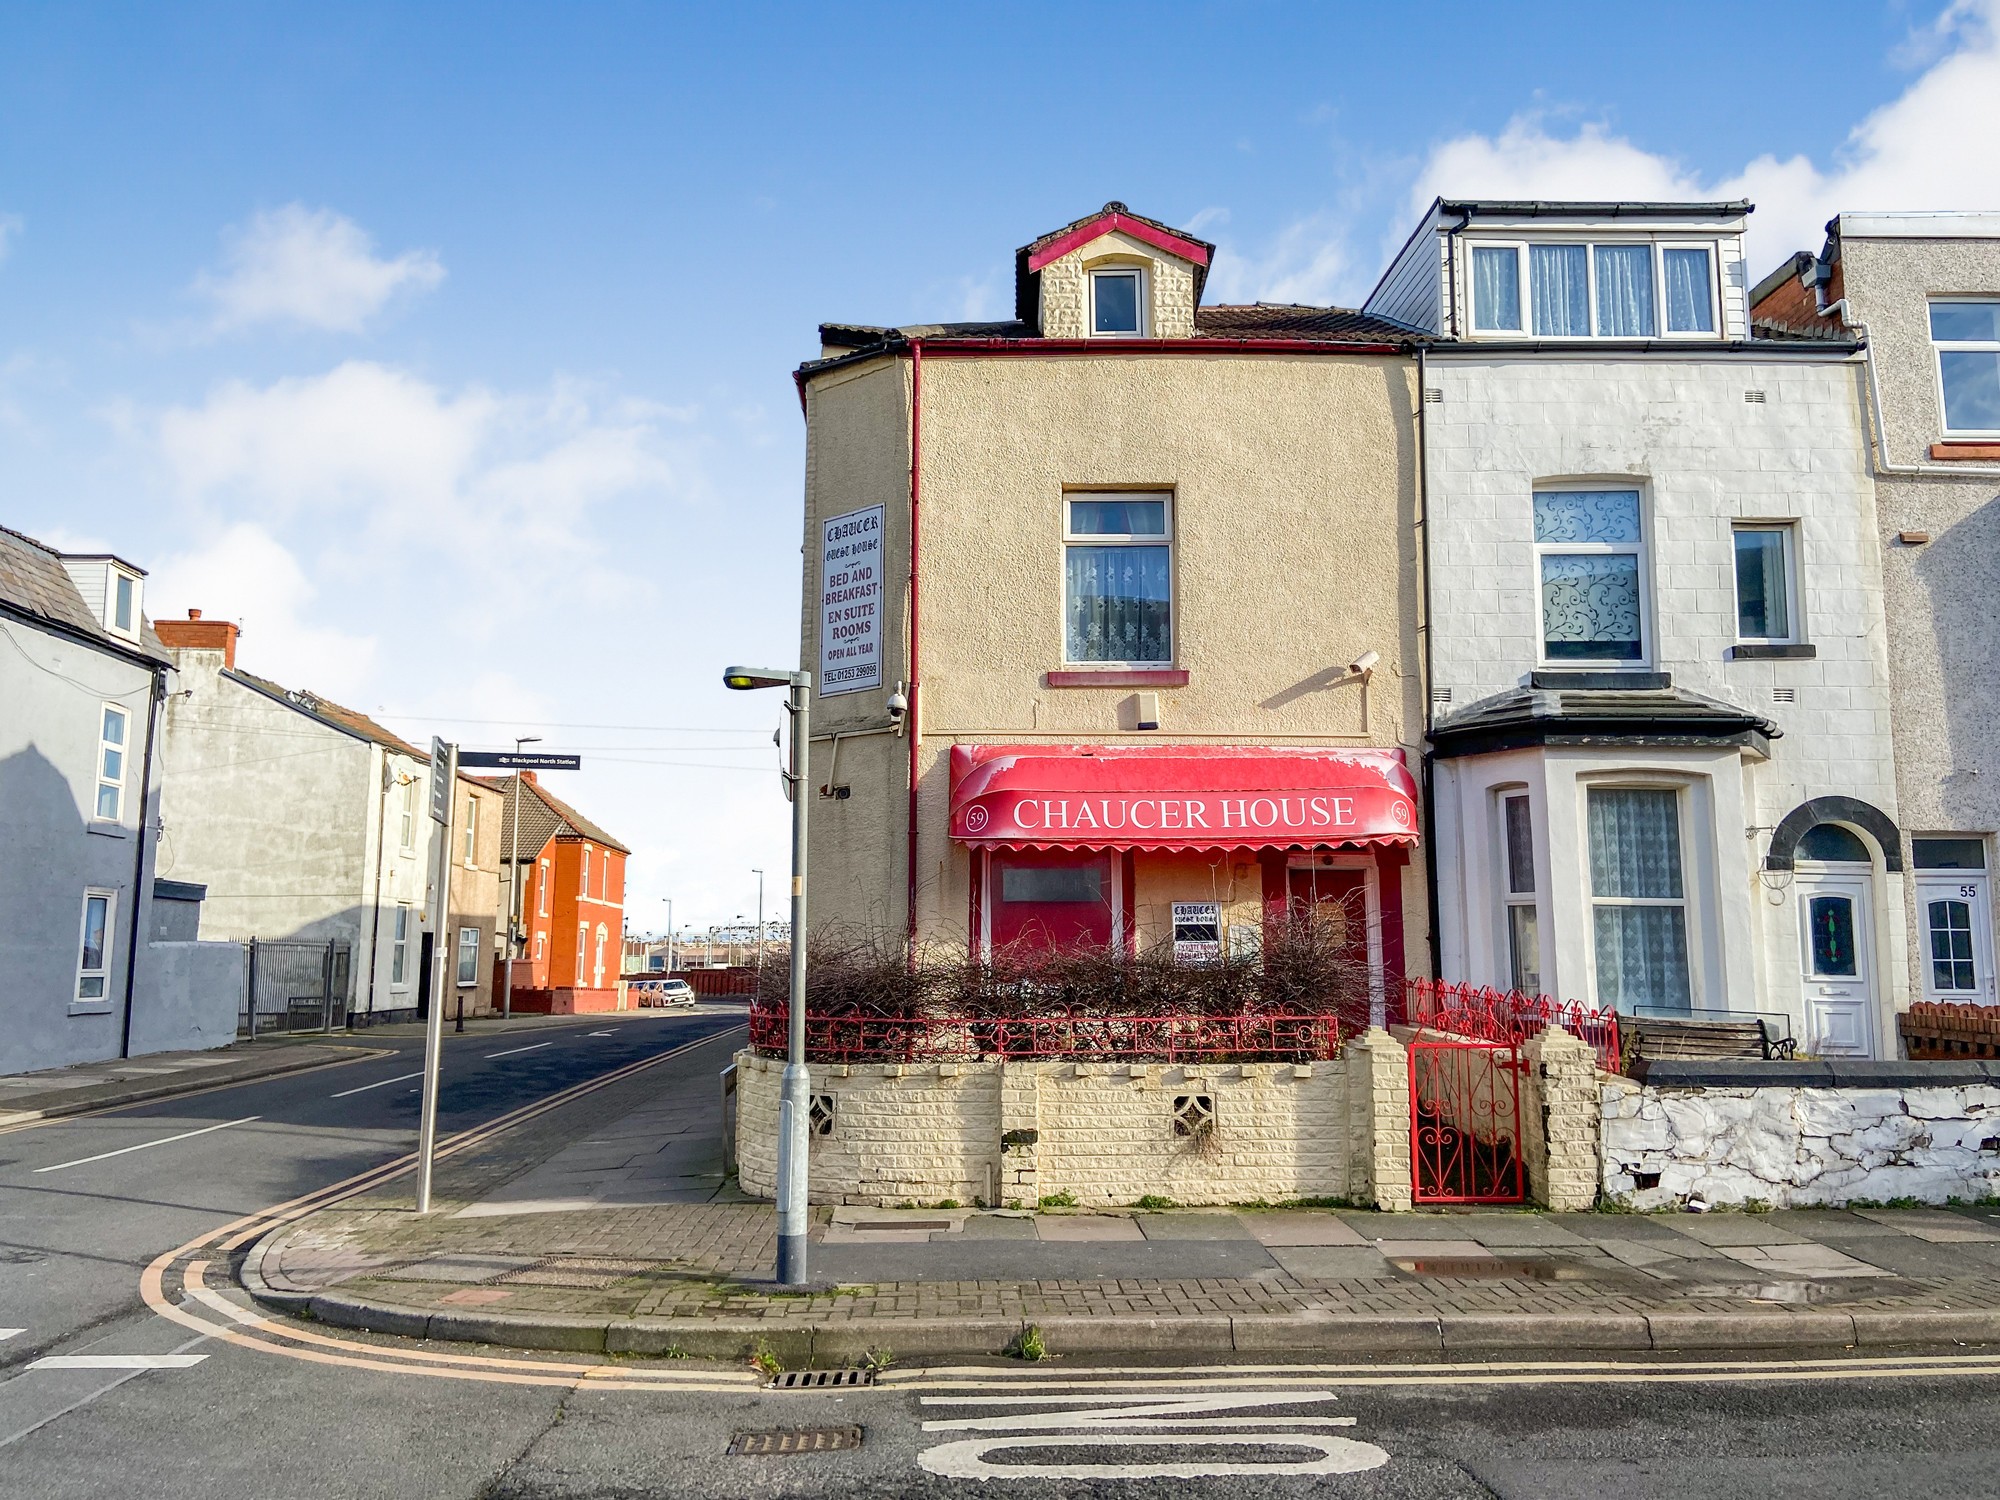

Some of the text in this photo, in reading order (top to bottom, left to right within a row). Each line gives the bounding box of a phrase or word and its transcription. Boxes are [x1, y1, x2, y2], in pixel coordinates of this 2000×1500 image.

[827, 515, 879, 542] CHAUCER
[826, 538, 878, 561] GUEST HOUSE
[830, 566, 872, 588] BED AND
[825, 582, 877, 605] BREAKFAST
[828, 603, 875, 624] EN SUITE
[832, 620, 871, 640] ROOMS
[828, 642, 873, 660] OPEN ALL YEAR
[824, 672, 836, 682] TEL:
[837, 669, 855, 680] 01253
[512, 757, 539, 765] Blackpool
[969, 812, 983, 825] 59
[1013, 797, 1357, 829] CHAUCER HOUSE
[1396, 808, 1407, 820] 59
[1960, 886, 1976, 897] 55
